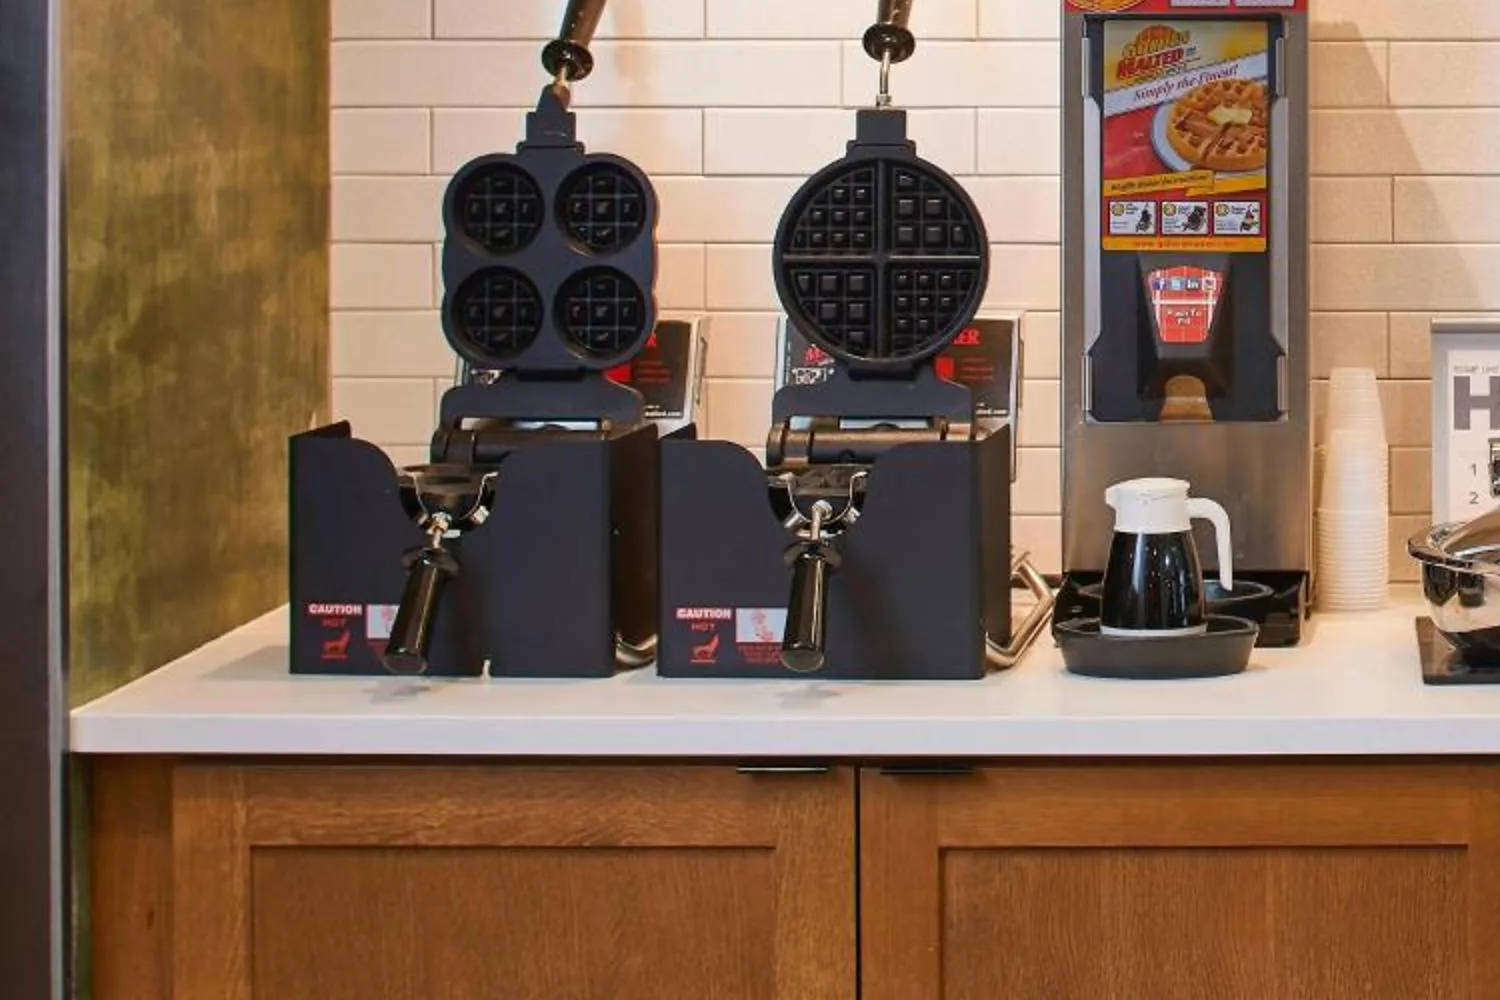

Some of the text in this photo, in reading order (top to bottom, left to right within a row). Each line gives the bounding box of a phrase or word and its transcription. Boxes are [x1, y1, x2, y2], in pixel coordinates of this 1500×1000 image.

[1135, 81, 1175, 100] Simply
[1177, 76, 1196, 89] the
[1470, 463, 1477, 476] 1
[1469, 492, 1479, 505] 2
[308, 603, 363, 615] CAUTION
[676, 607, 732, 619] CAUTION
[691, 622, 715, 631] HOT
